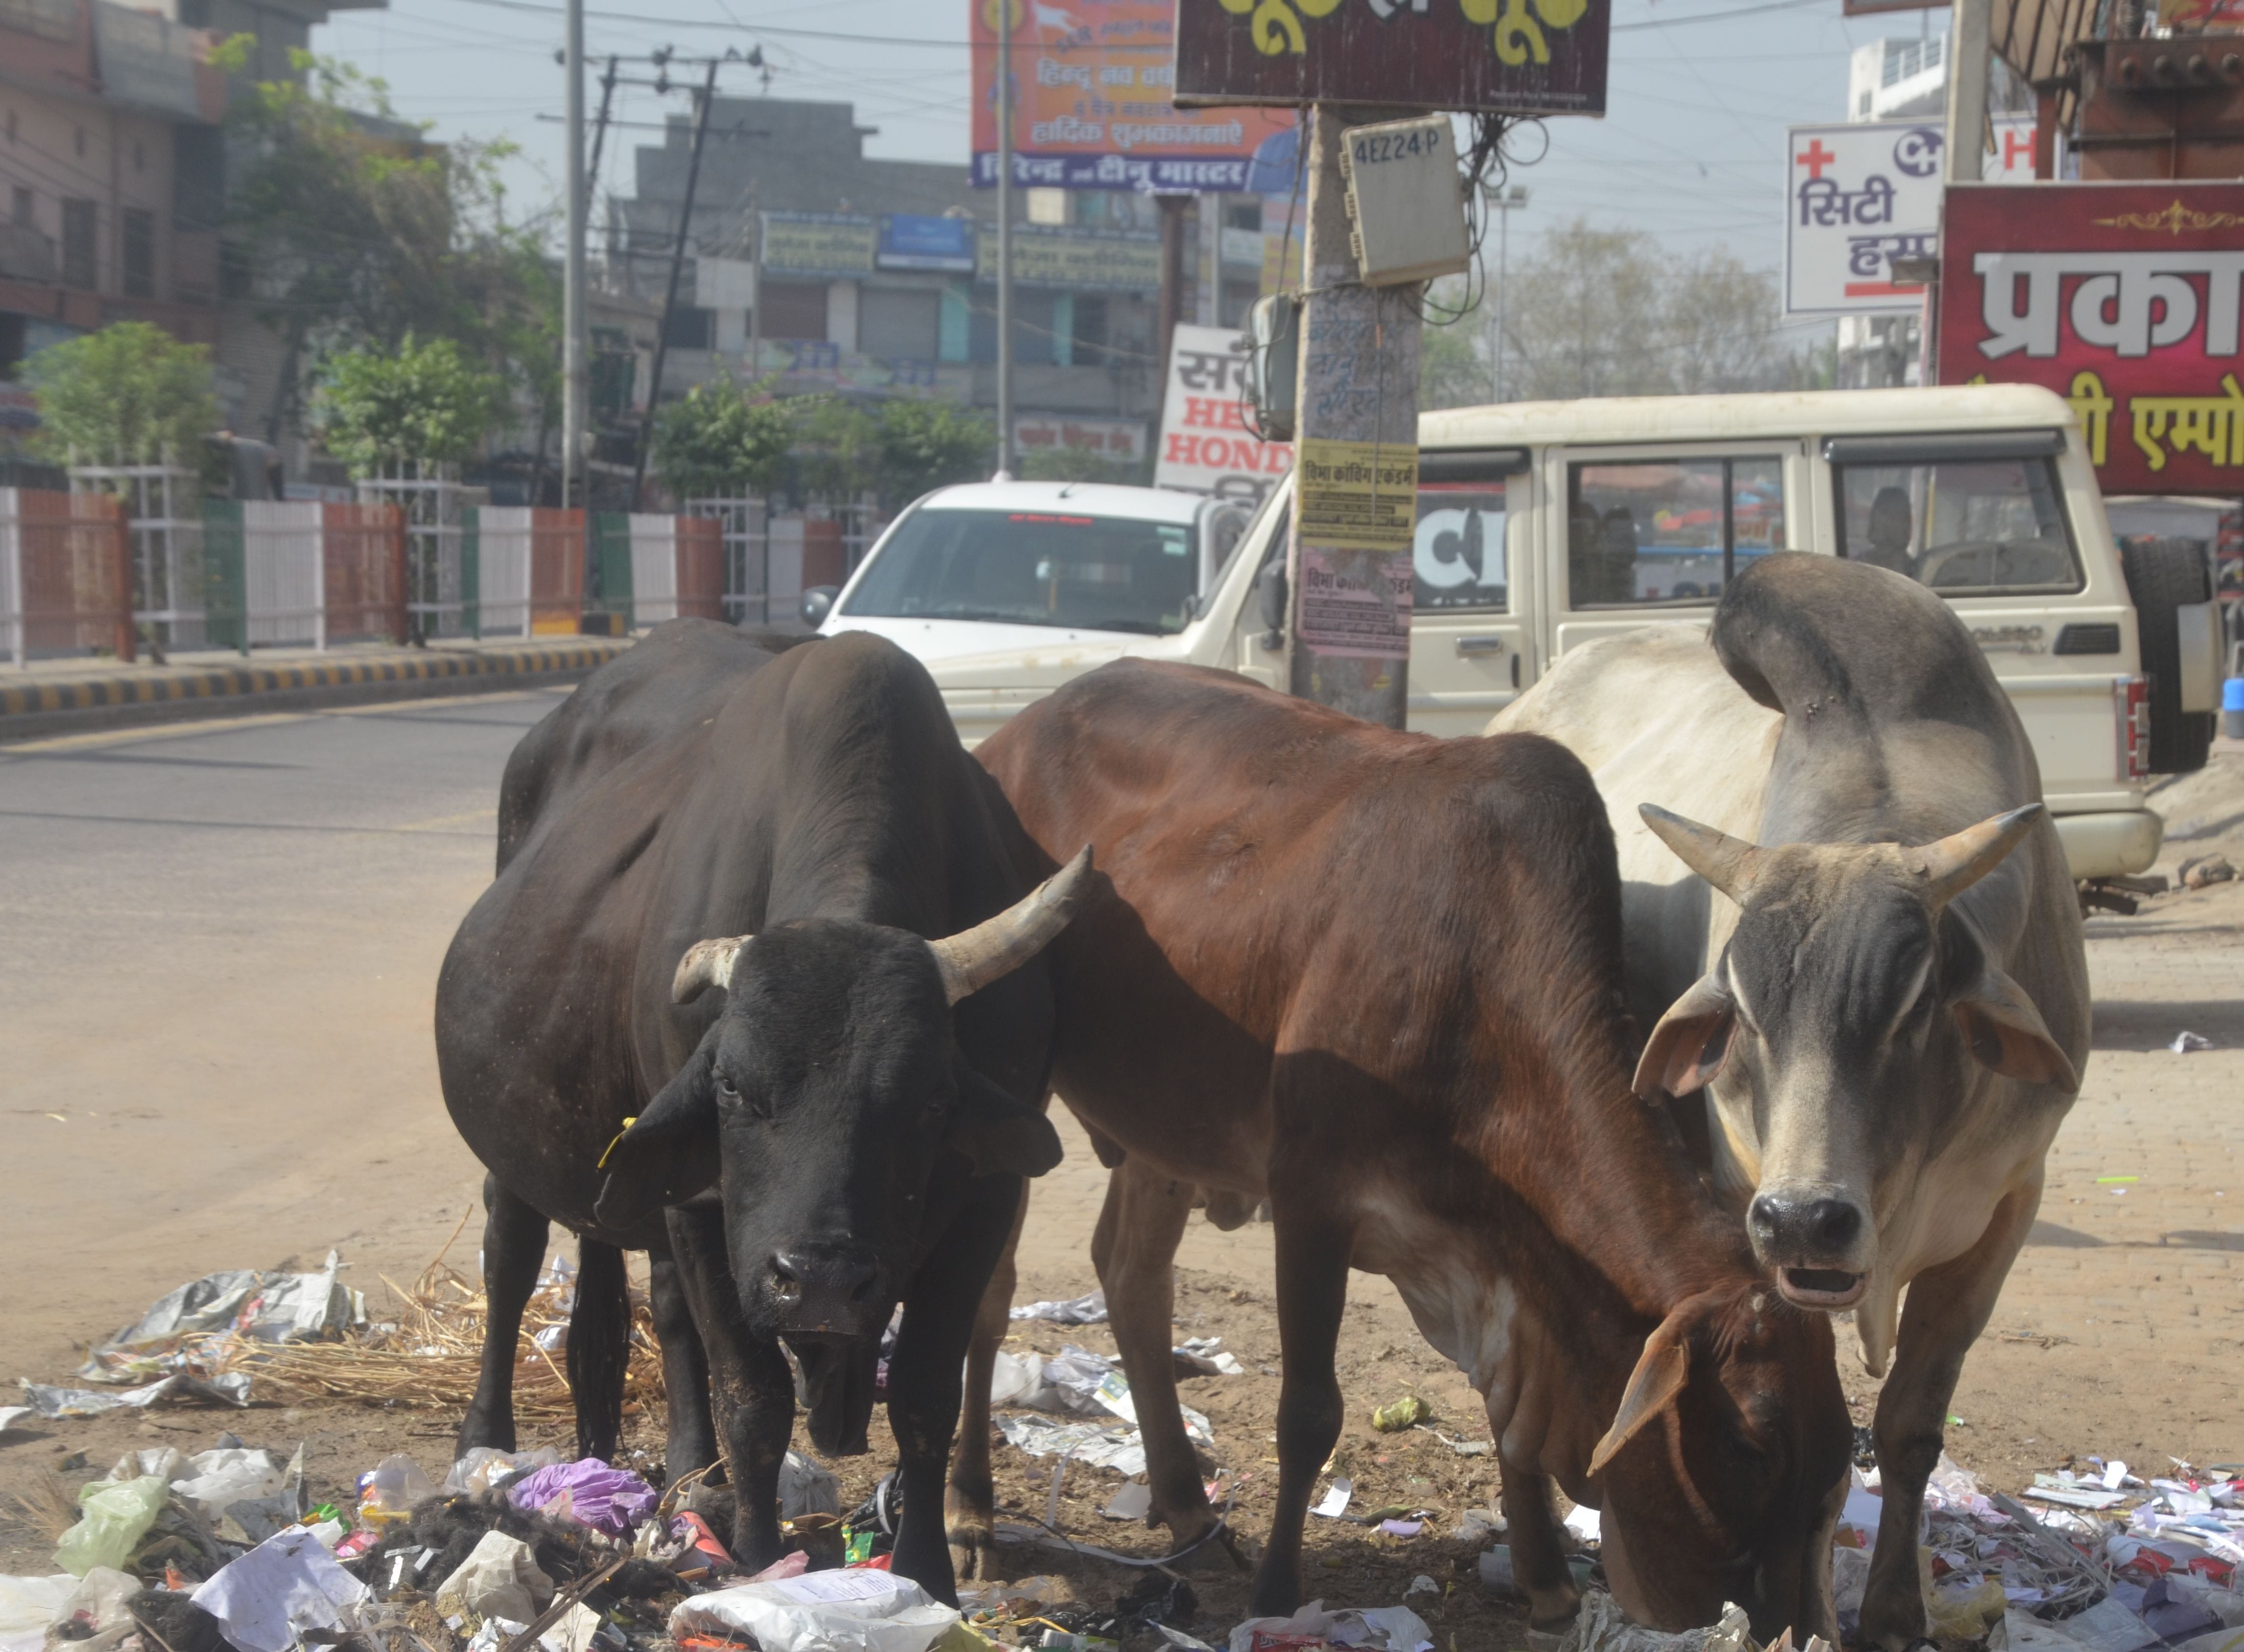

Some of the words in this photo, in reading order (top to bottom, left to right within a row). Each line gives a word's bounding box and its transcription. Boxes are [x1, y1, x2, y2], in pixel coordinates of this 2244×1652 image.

[1797, 175, 1896, 226] सिटी
[1974, 252, 2244, 359] प्रका
[1165, 433, 1293, 474] HOND
[2130, 373, 2244, 471] एम्पो
